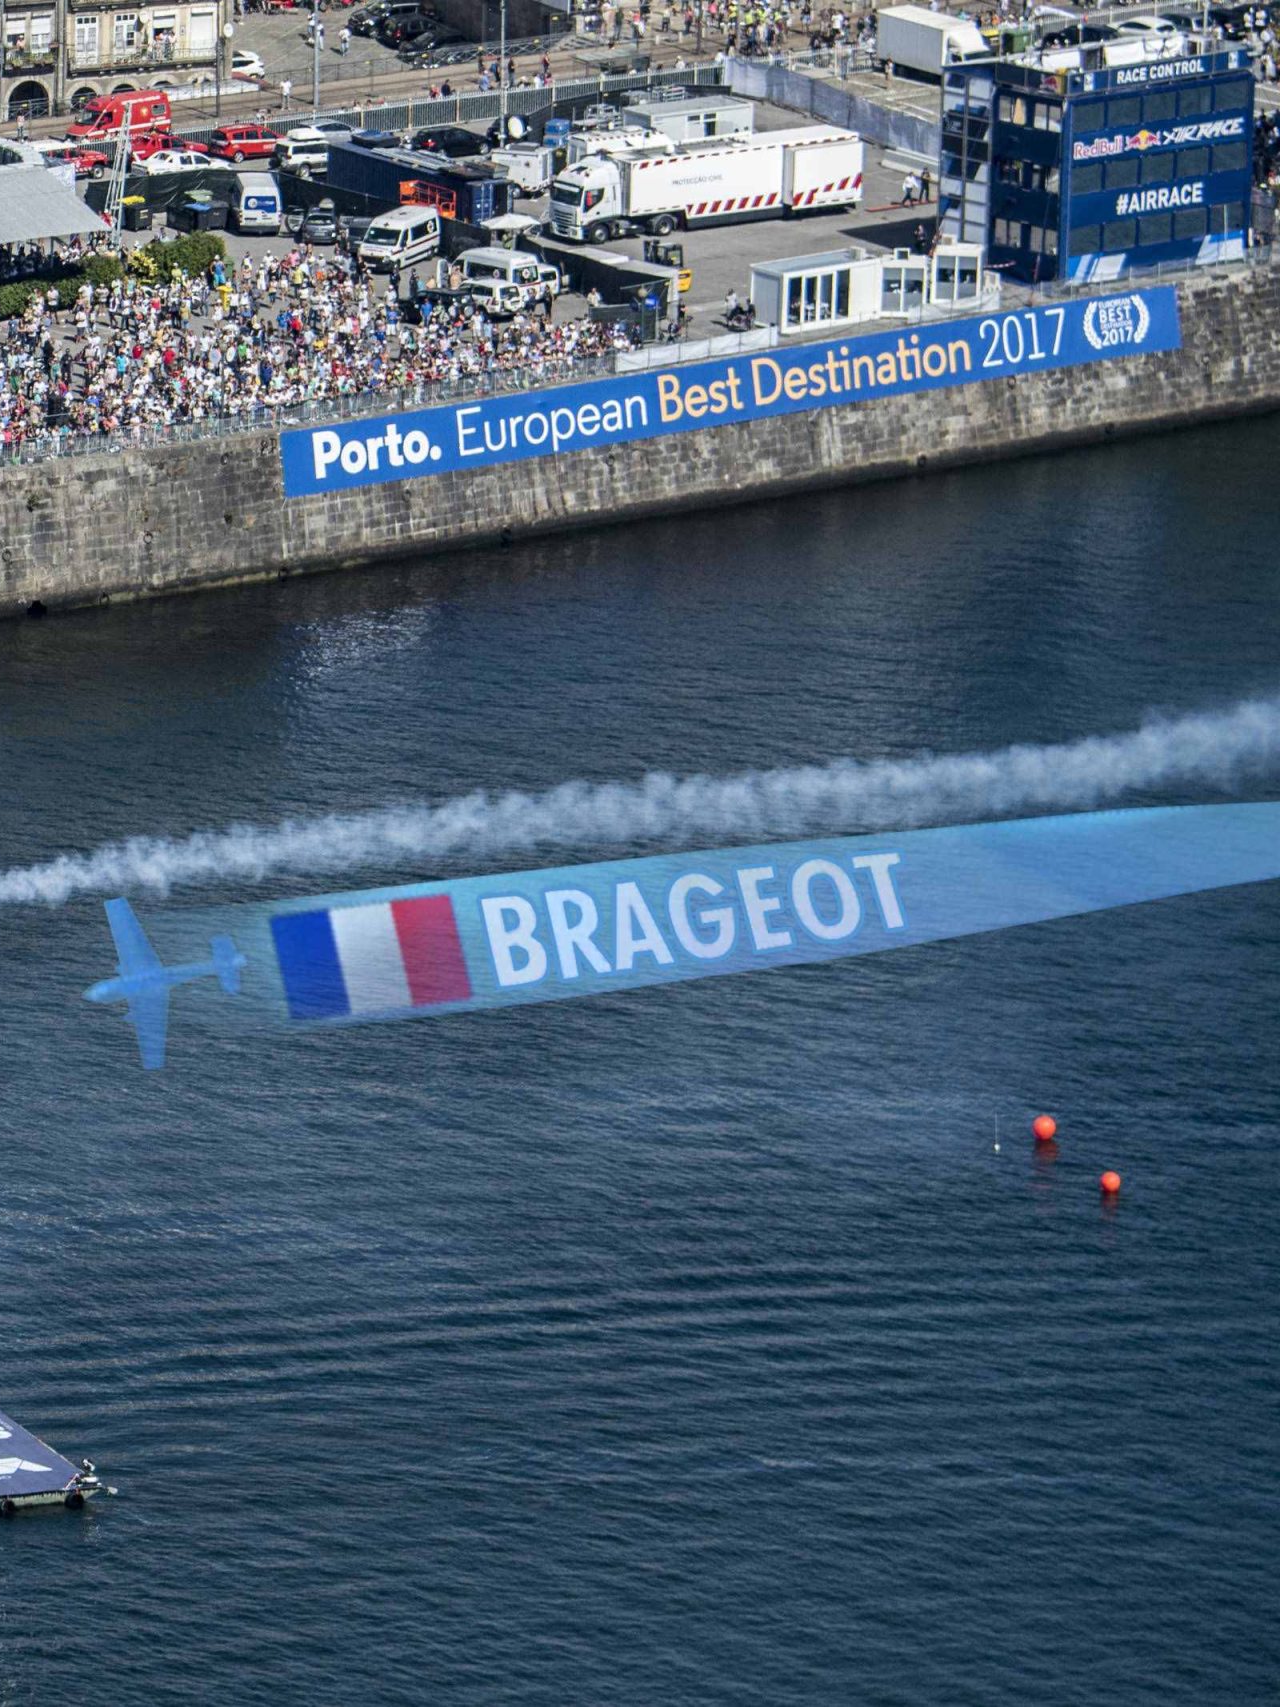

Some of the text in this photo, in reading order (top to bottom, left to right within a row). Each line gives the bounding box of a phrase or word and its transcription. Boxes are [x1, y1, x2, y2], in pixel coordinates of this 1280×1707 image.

[1116, 58, 1206, 85] RACE CONTROL
[1072, 138, 1099, 160] Red
[1098, 134, 1124, 156] Bull
[1197, 117, 1244, 139] RACE
[1116, 182, 1203, 215] #AIRRACE
[1099, 305, 1131, 324] BEST
[1101, 326, 1133, 346] 2017
[311, 308, 1066, 479] Porto. European Best Destination 2017
